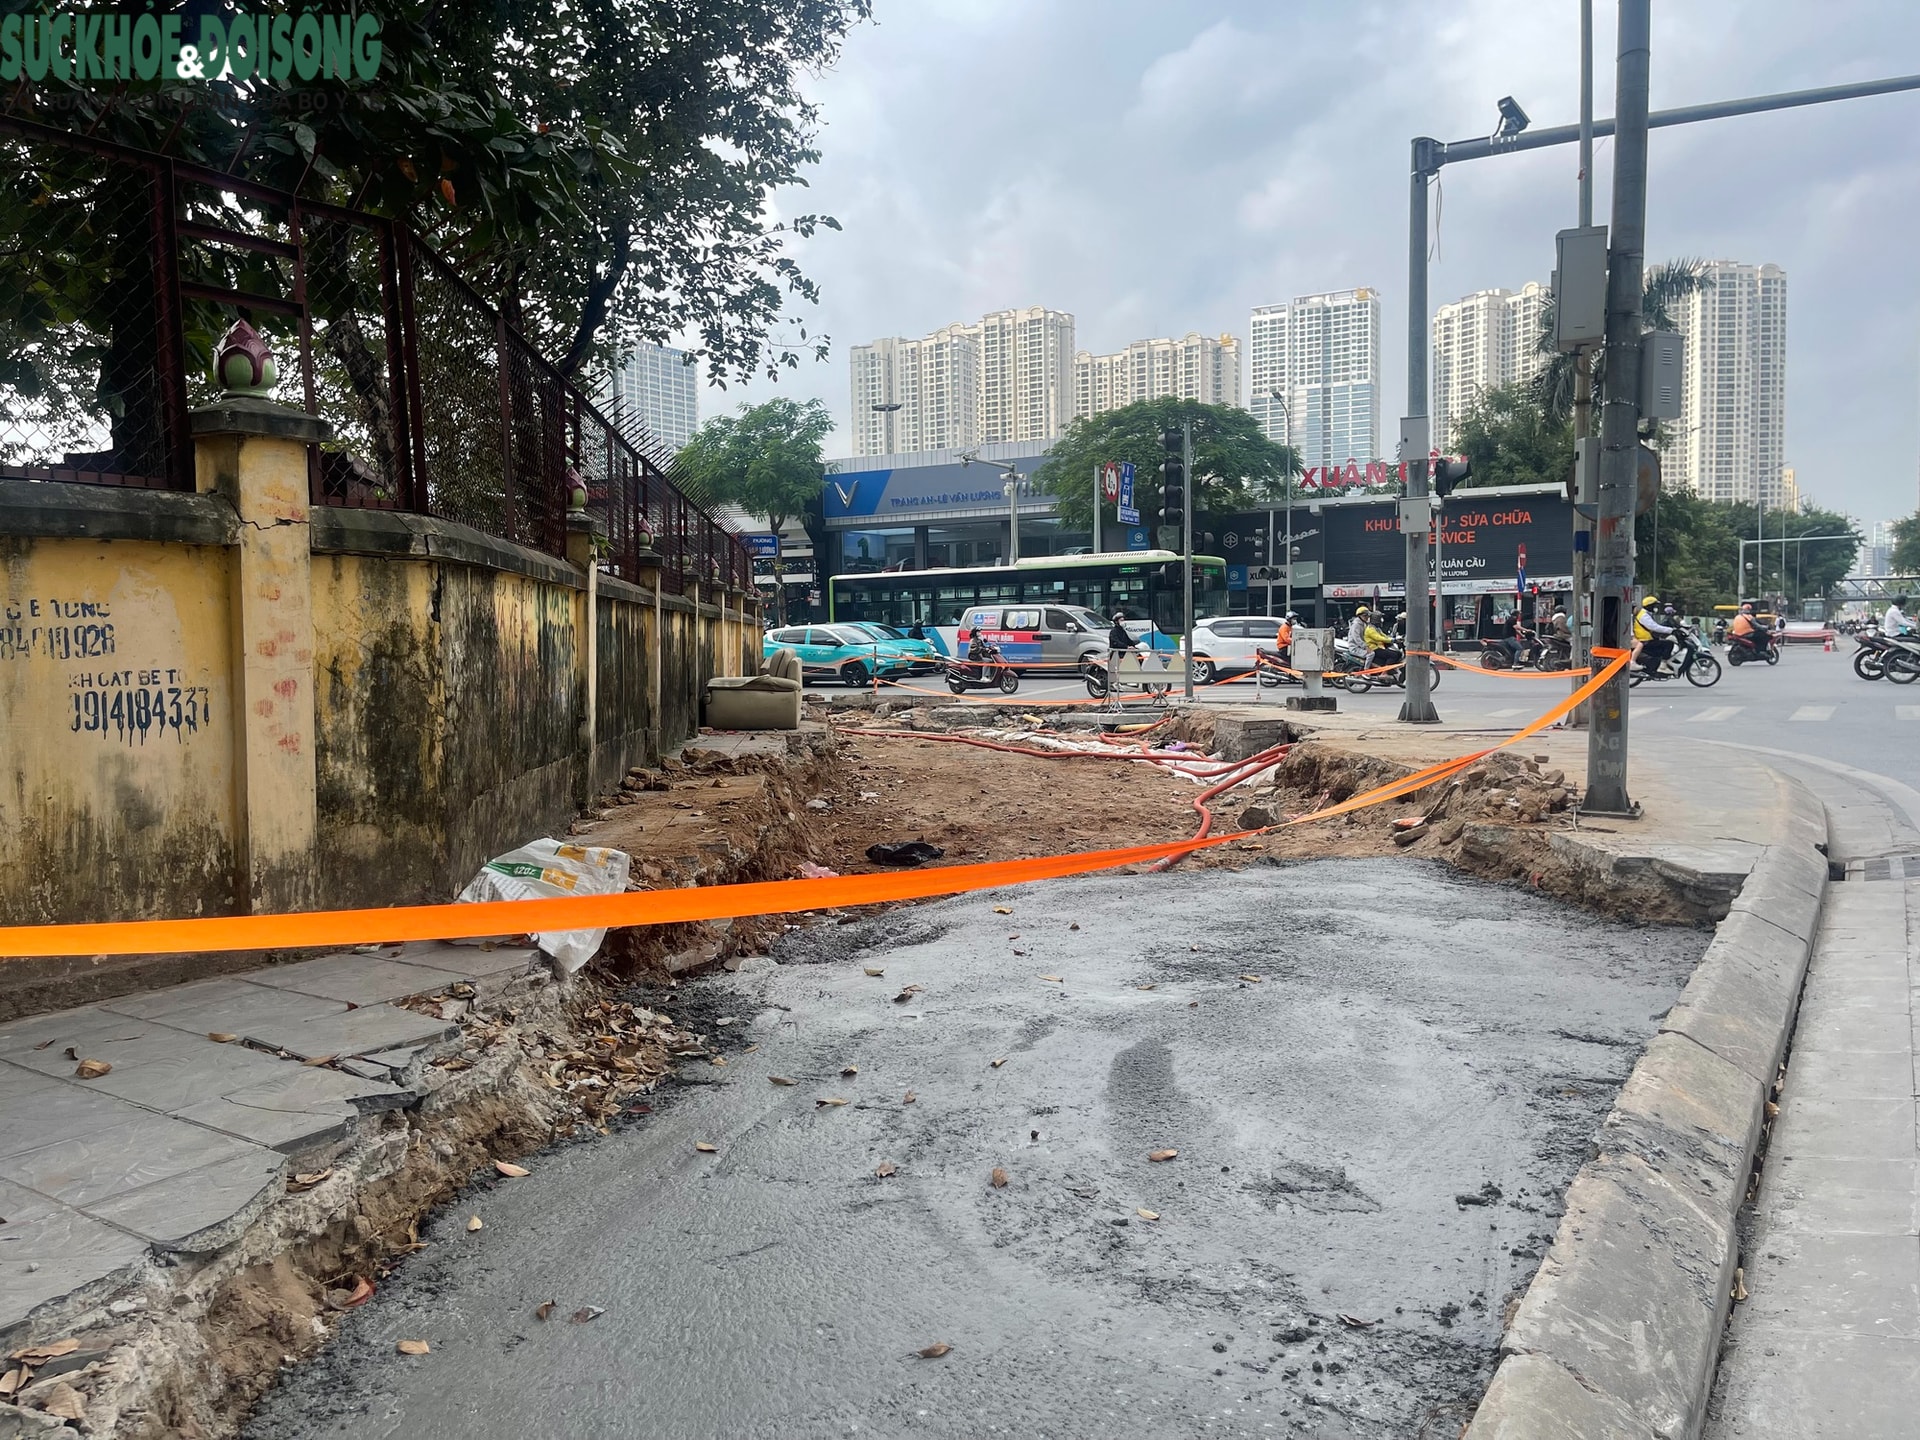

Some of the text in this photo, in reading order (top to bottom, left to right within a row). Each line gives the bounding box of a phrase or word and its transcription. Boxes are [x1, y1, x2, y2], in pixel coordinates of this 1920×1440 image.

[1300, 458, 1387, 489] XUÂN
[1365, 520, 1393, 532] KHU
[1459, 510, 1489, 527] SỬA
[1492, 509, 1532, 526] CHỮA
[1427, 531, 1476, 545] ERVICE
[1465, 555, 1486, 568] CẦU
